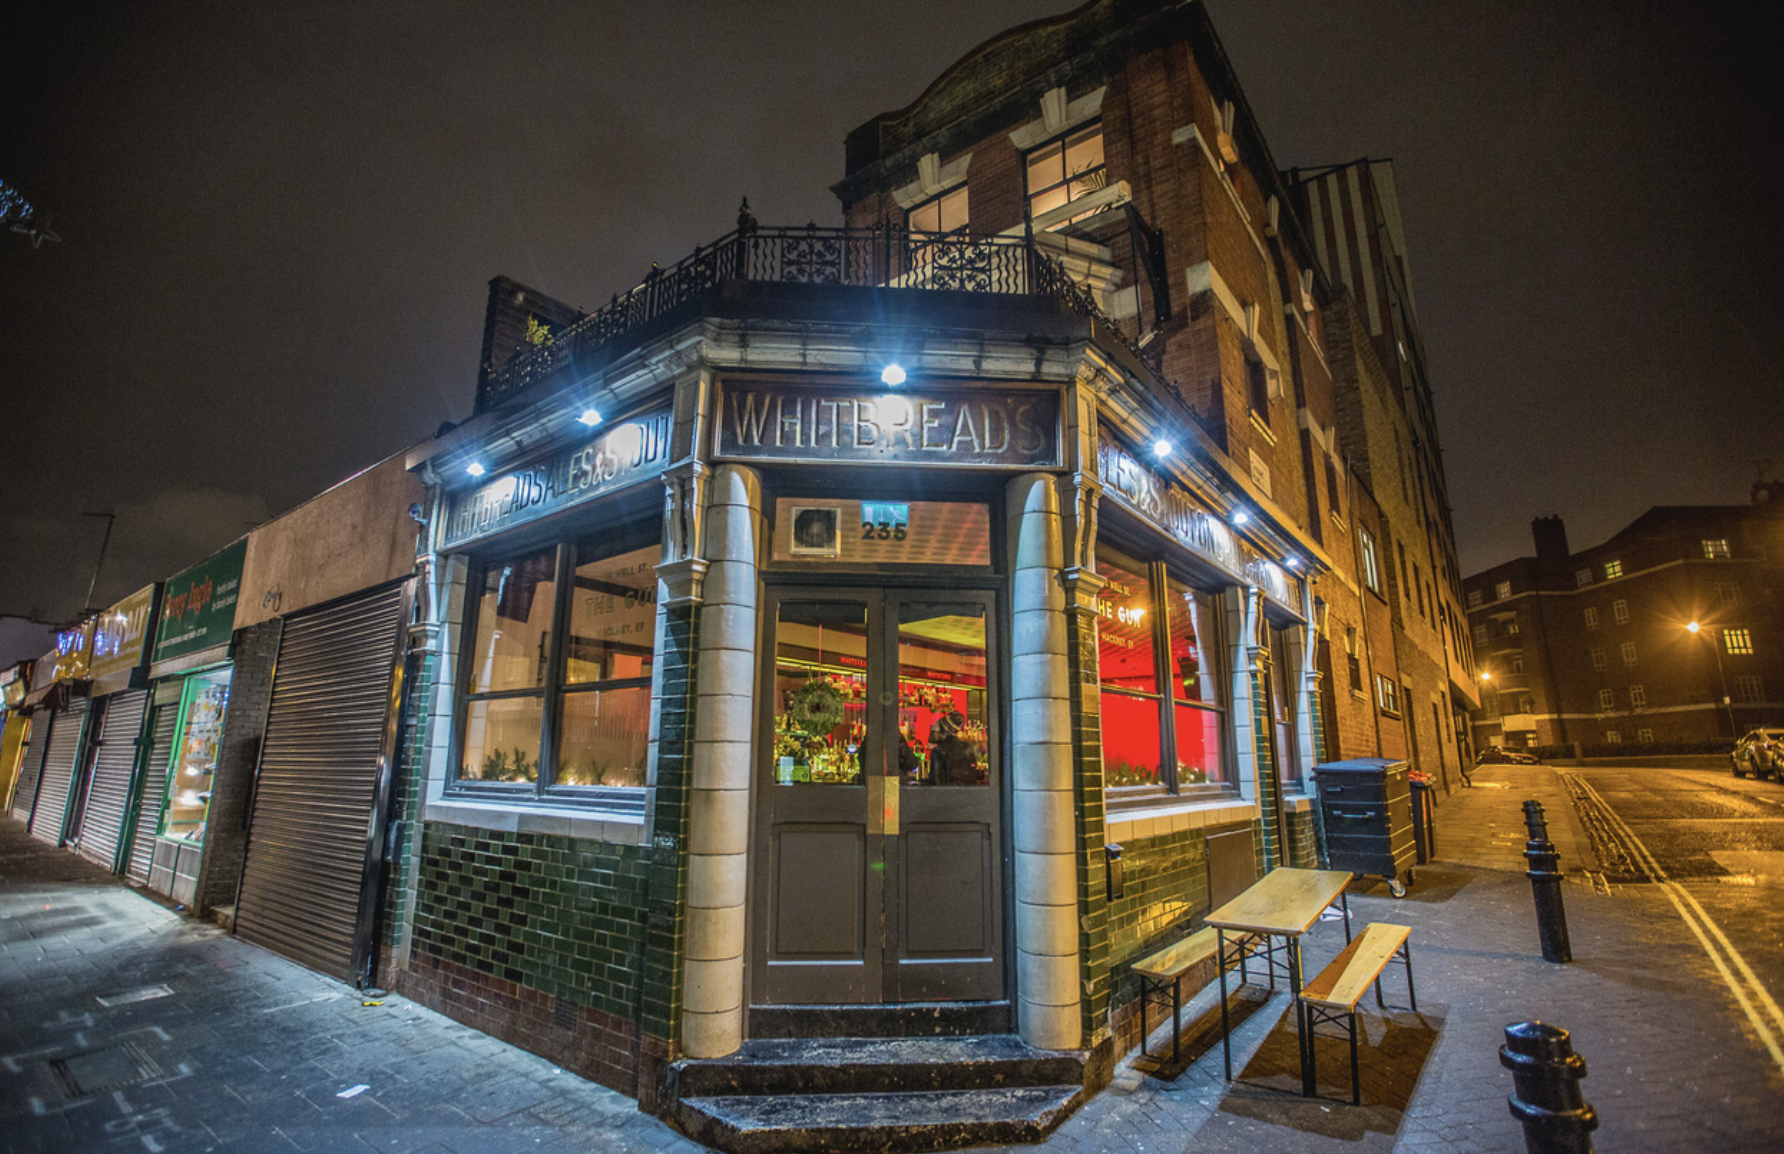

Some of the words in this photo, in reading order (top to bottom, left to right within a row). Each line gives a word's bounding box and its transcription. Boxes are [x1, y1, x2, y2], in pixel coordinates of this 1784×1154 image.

[731, 391, 1044, 455] WHITBREAD'S
[862, 521, 907, 541] 235
[585, 593, 614, 617] THE
[1097, 597, 1113, 620] HE
